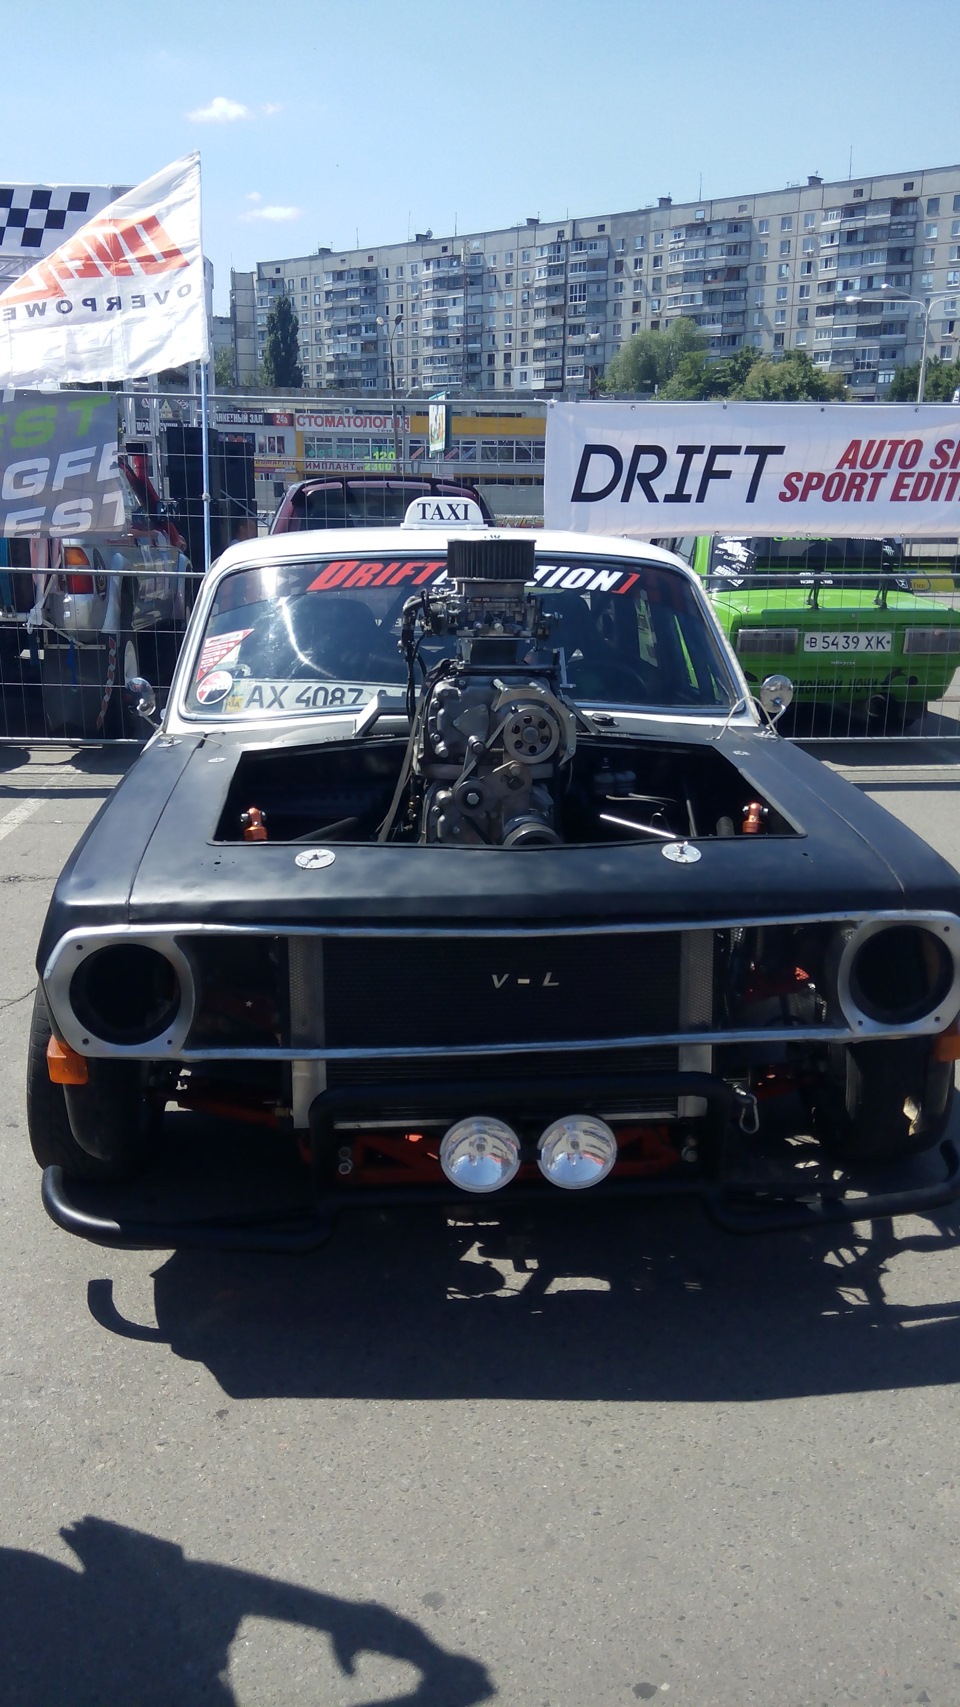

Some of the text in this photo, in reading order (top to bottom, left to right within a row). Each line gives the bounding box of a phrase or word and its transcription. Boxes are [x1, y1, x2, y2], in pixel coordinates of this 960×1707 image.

[835, 439, 923, 470] AUTO
[305, 462, 355, 471] ИМПЛАНТ
[570, 443, 786, 503] DRIFT
[778, 471, 888, 503] SPORT
[417, 502, 471, 521] TAXI
[821, 635, 860, 650] 5439
[295, 686, 364, 708] 4087
